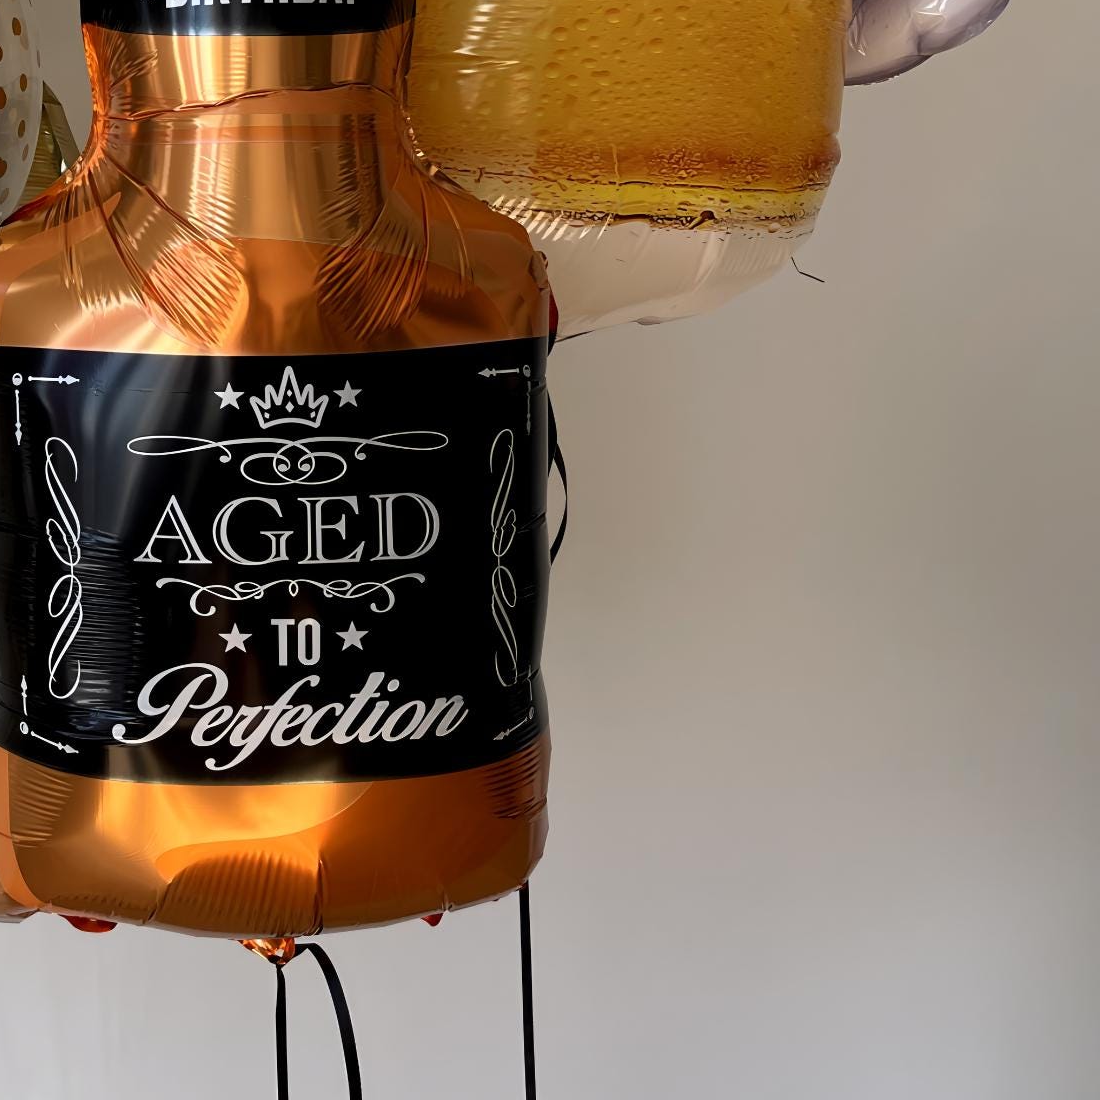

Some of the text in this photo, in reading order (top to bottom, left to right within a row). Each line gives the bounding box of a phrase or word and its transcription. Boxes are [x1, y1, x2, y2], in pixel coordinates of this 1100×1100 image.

[133, 492, 440, 565] AGED
[271, 618, 321, 666] TO
[112, 662, 468, 771] Perfection
